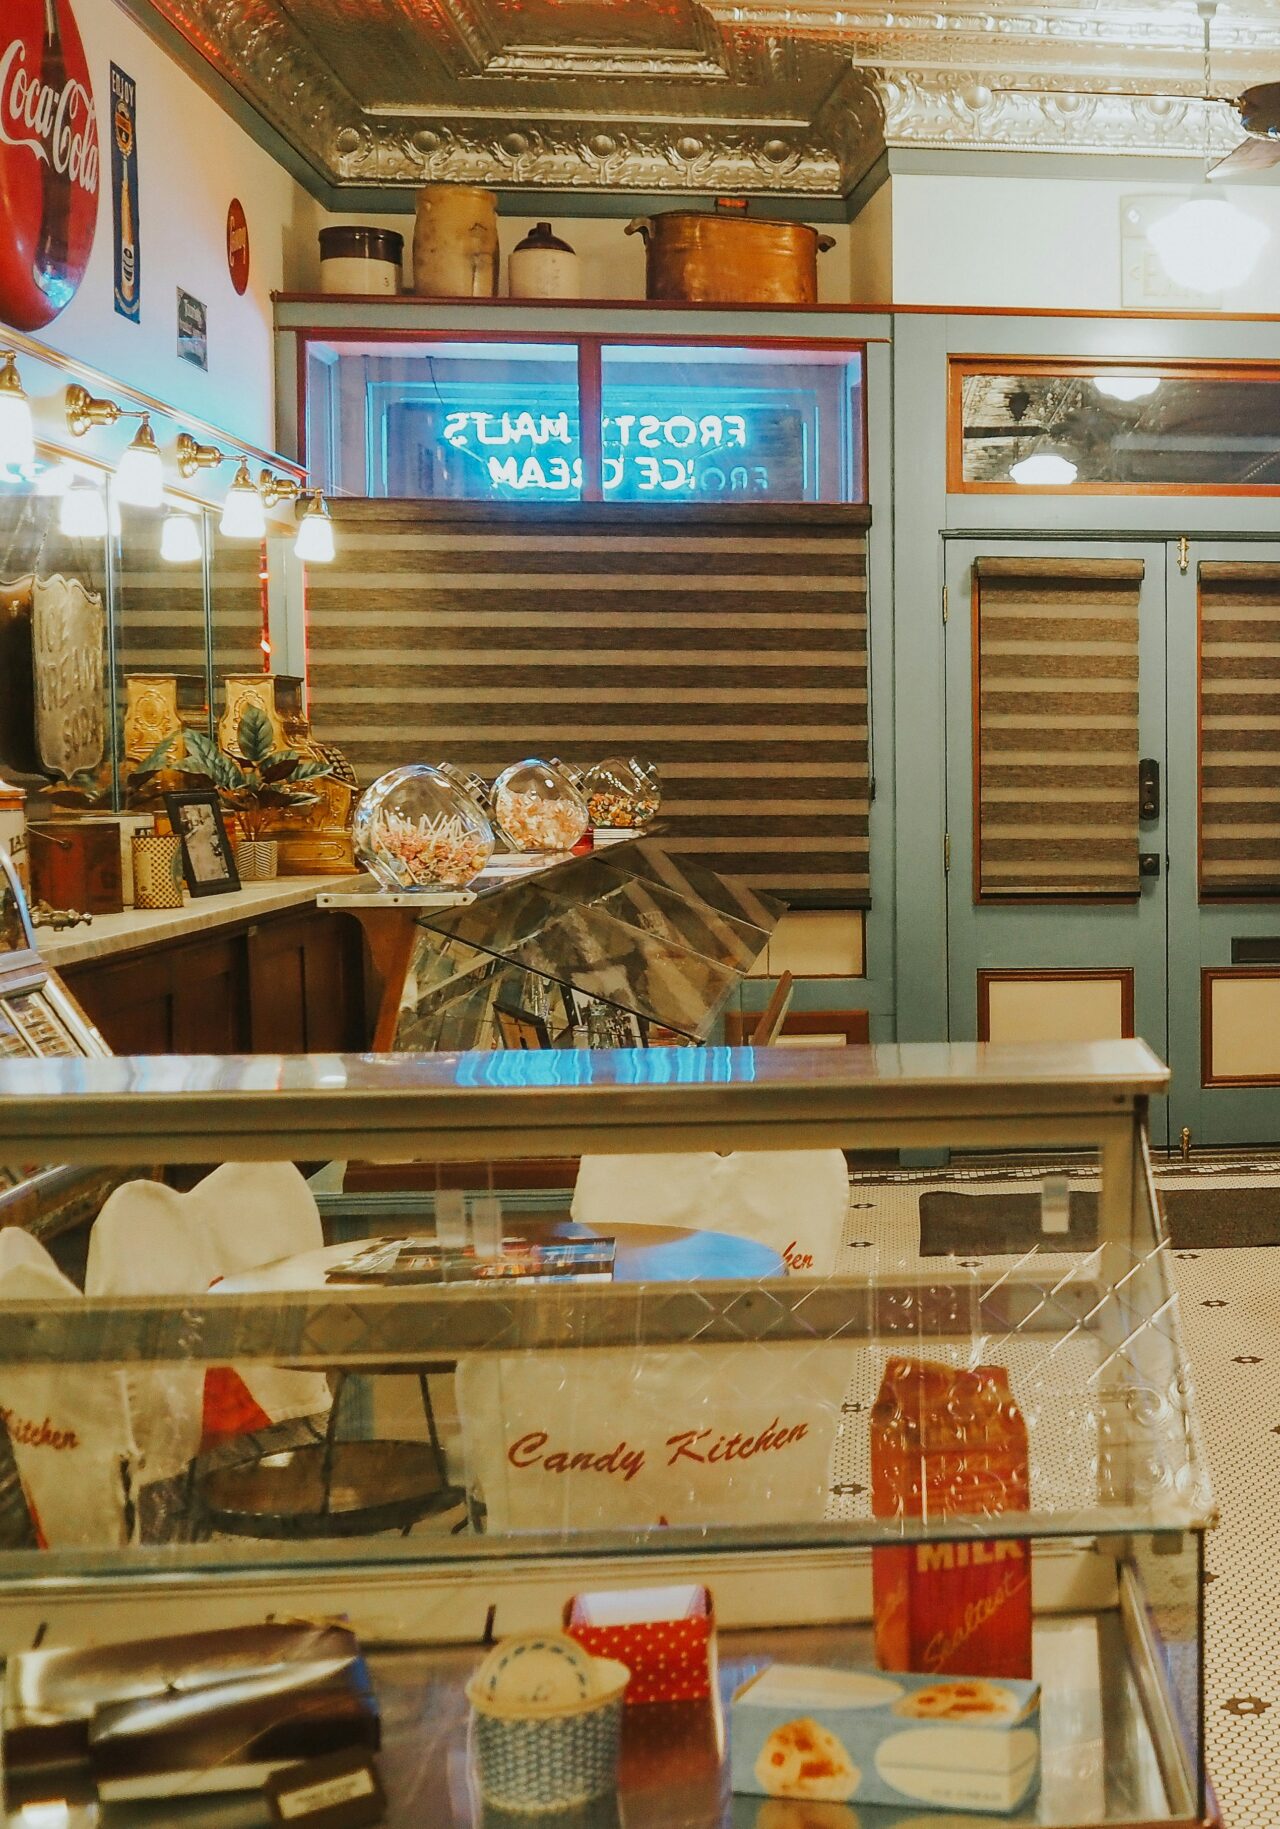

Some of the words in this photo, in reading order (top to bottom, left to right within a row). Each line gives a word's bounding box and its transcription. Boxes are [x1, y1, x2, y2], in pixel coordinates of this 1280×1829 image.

[112, 69, 134, 107] ENJOY
[0, 40, 98, 193] Coca-Cola
[508, 1431, 645, 1481] Candy
[666, 1416, 808, 1466] Kitchen
[917, 1541, 1024, 1573] MILK
